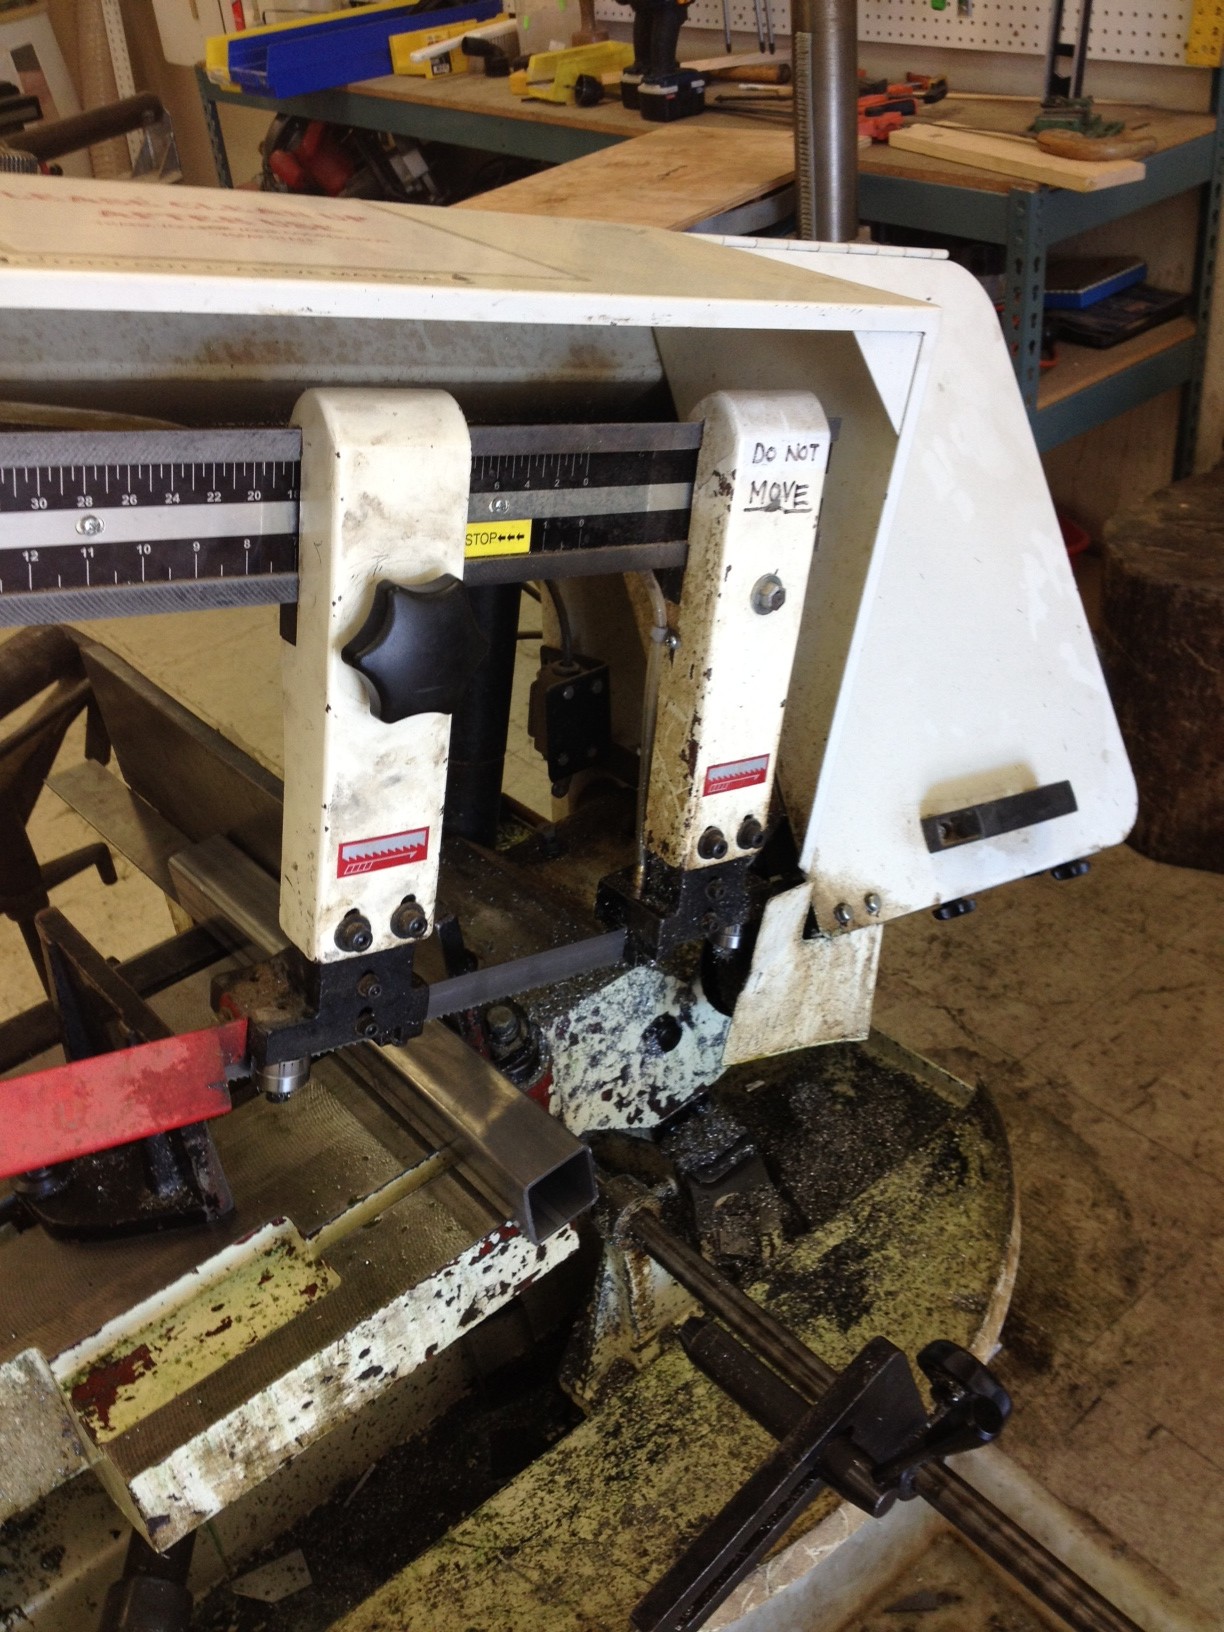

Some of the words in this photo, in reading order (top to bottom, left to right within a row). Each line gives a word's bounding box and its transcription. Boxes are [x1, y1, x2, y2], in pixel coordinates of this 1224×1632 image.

[752, 442, 777, 464] DO
[785, 443, 820, 462] NOT
[494, 481, 500, 490] 6
[524, 480, 530, 488] 4
[554, 478, 560, 488] 2
[583, 477, 589, 486] 0
[30, 497, 48, 510] 30
[77, 495, 94, 508] 28
[121, 494, 138, 506] 26
[165, 492, 181, 505] 24
[207, 491, 222, 503] 22
[247, 490, 262, 501] 20
[749, 480, 809, 508] MOVE
[579, 518, 585, 528] 0
[465, 532, 498, 546] STOP
[22, 550, 39, 562] 12
[80, 547, 95, 559] 11
[136, 543, 152, 555] 10
[192, 541, 201, 552] 9
[243, 538, 251, 549] 8
